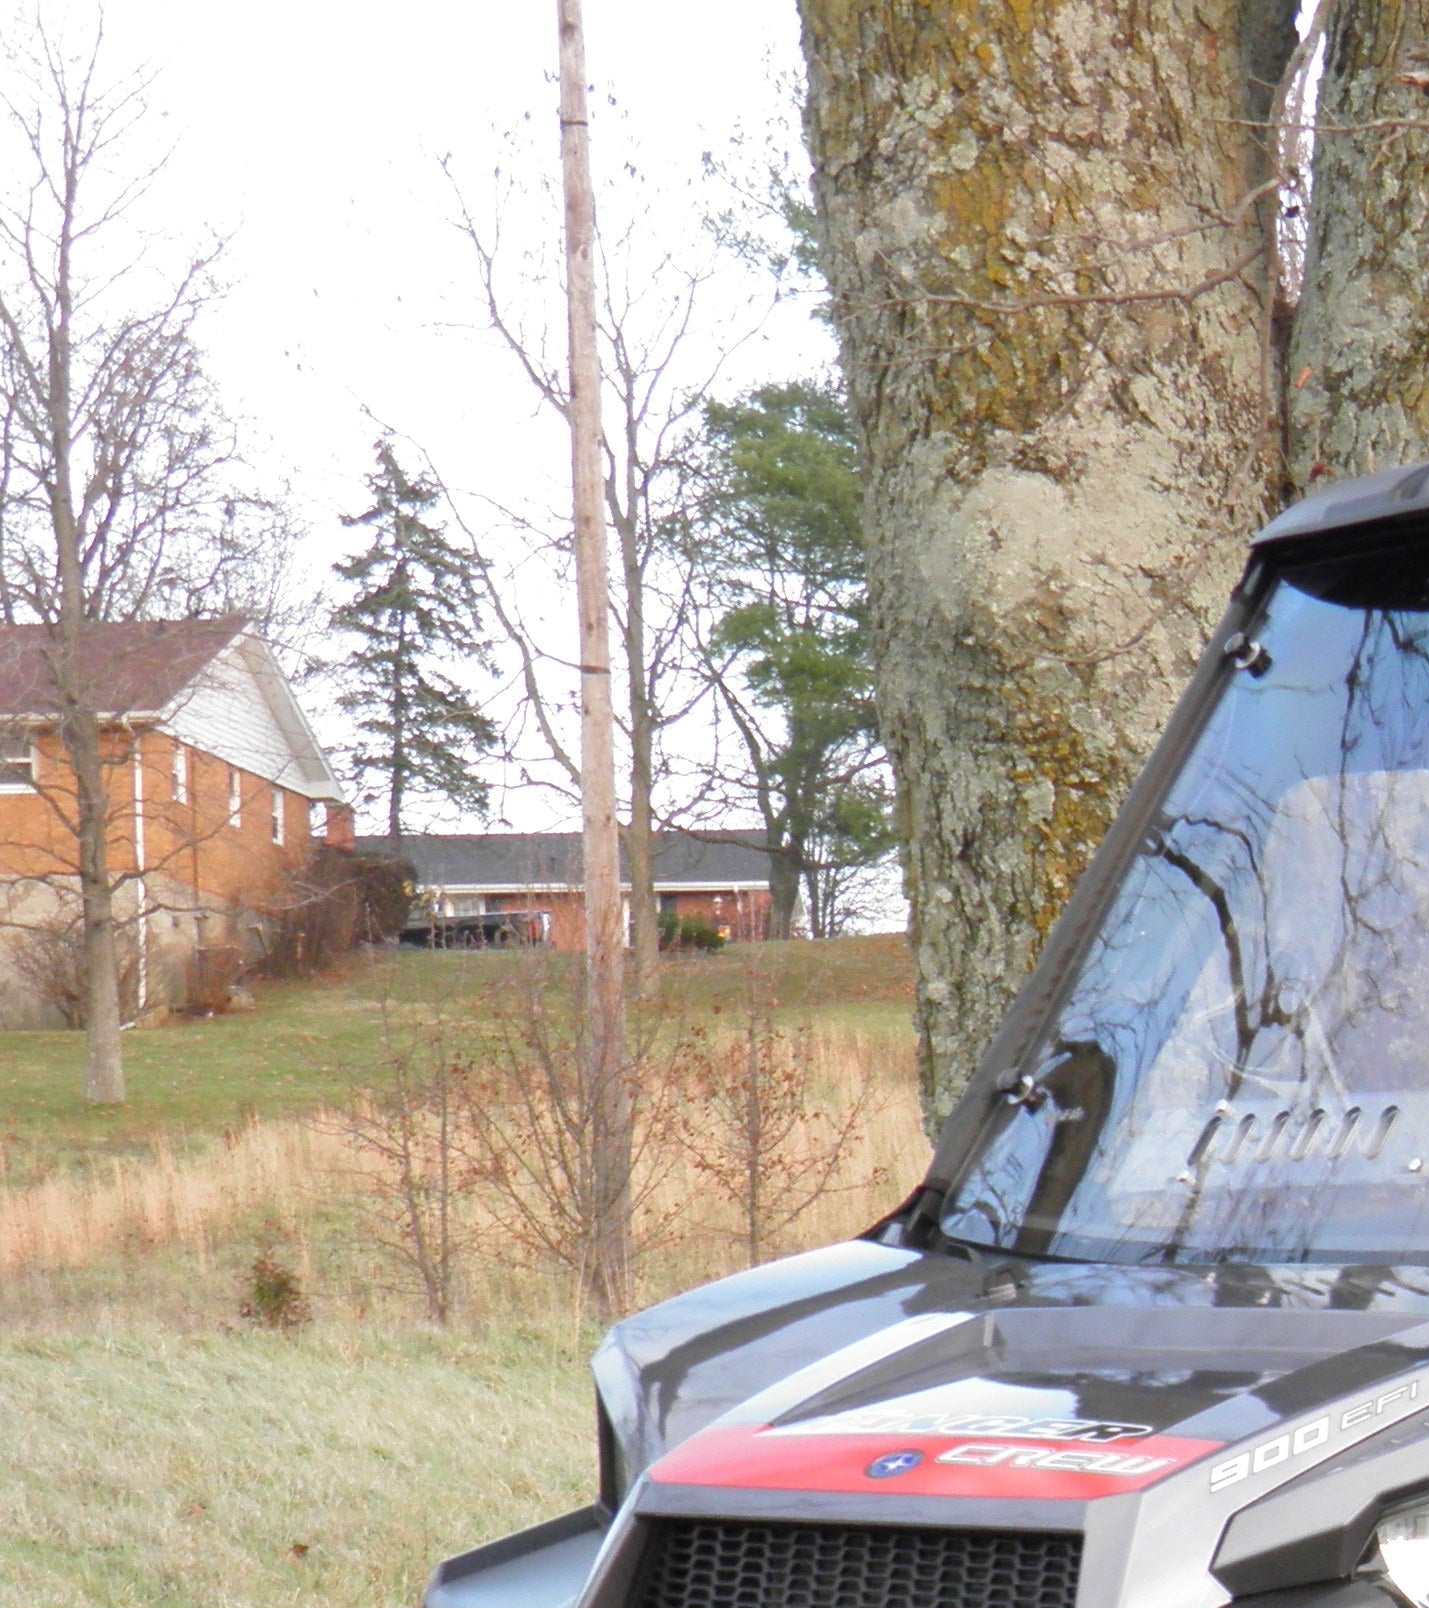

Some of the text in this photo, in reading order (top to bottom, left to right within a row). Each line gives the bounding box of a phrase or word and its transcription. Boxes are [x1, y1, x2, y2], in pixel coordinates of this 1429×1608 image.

[936, 1443, 1177, 1476] CREW
[1209, 1380, 1419, 1494] 900 EFI
